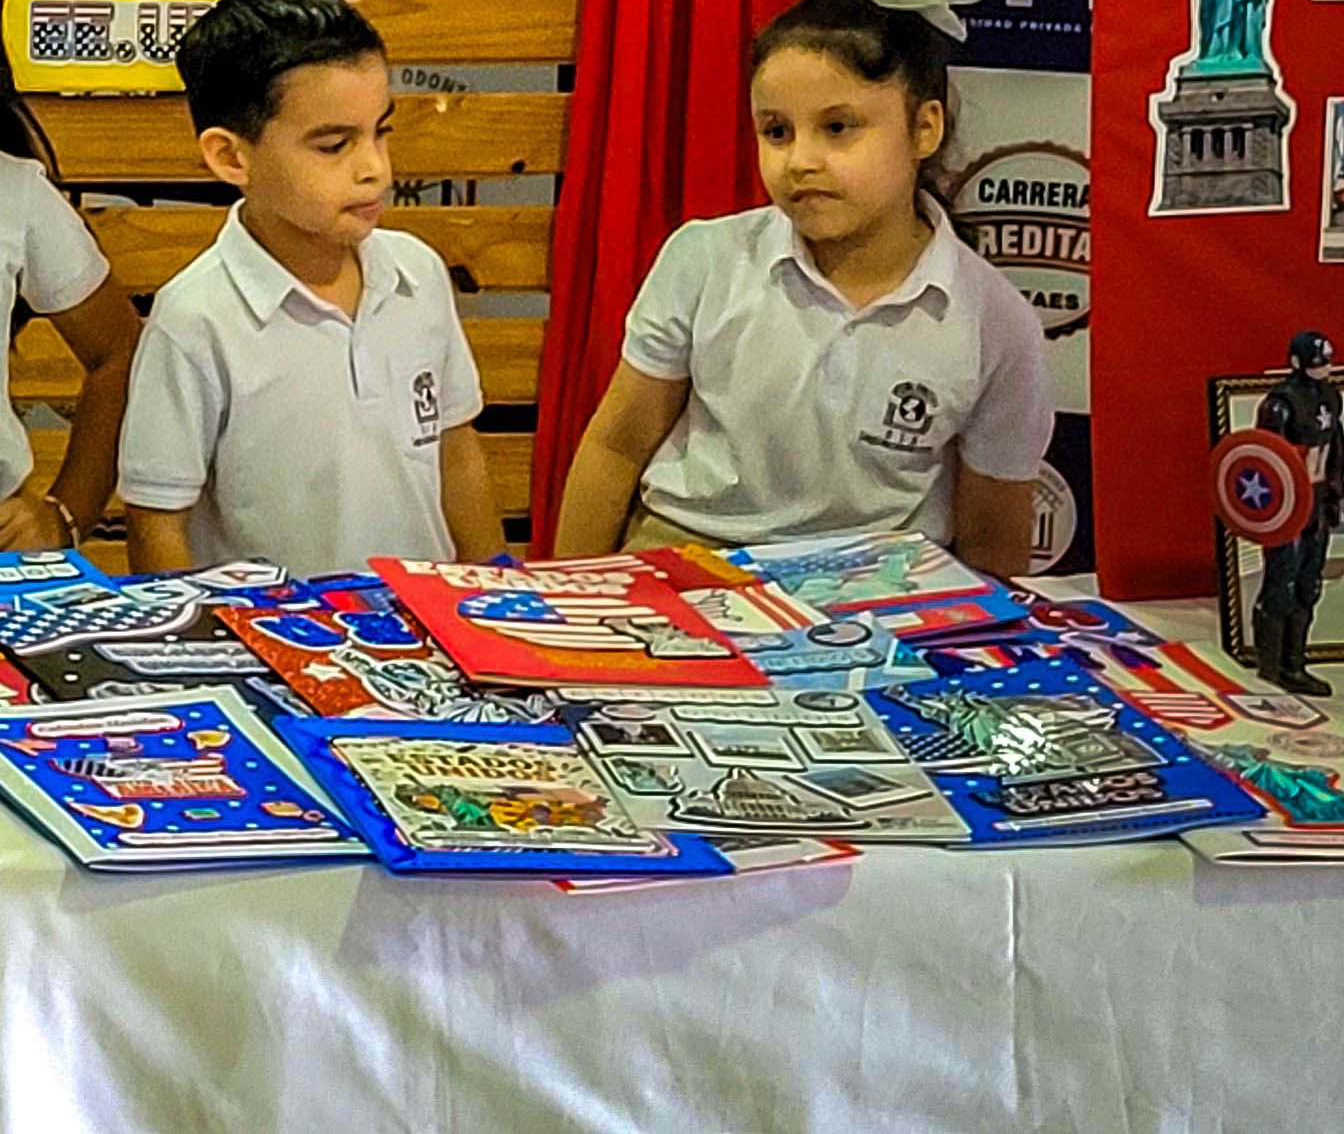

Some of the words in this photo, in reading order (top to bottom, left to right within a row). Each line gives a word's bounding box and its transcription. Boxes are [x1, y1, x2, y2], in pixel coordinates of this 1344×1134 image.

[401, 68, 469, 92] ODON
[978, 177, 1090, 209] CARRERA
[978, 224, 1090, 262] REDITA
